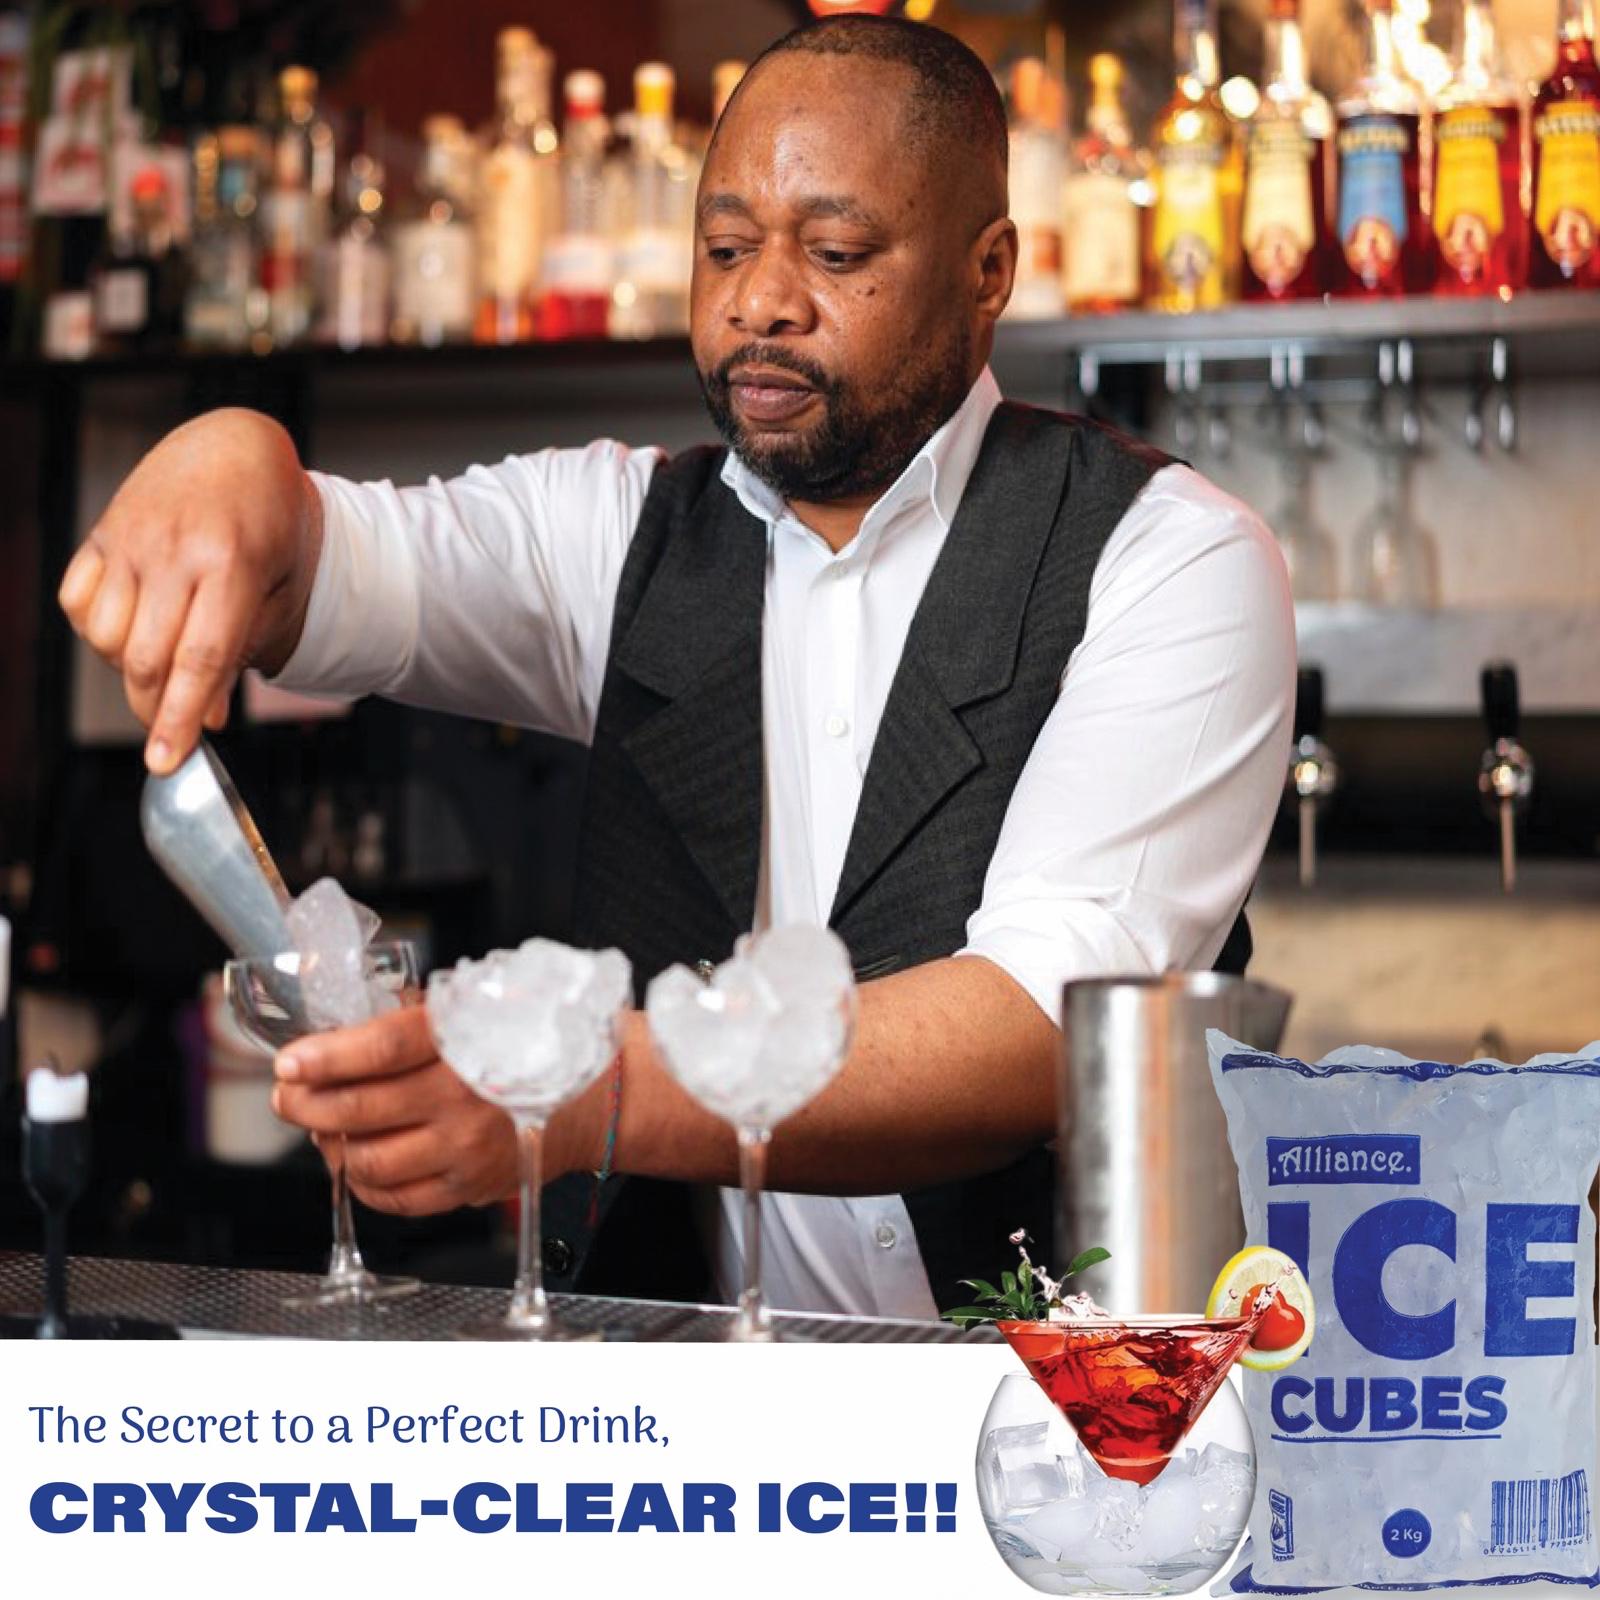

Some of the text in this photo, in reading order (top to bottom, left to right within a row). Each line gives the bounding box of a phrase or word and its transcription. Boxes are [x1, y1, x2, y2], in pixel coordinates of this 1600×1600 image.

[1270, 1374, 1508, 1433] CUBES
[1391, 1528, 1423, 1543] 2 Kg
